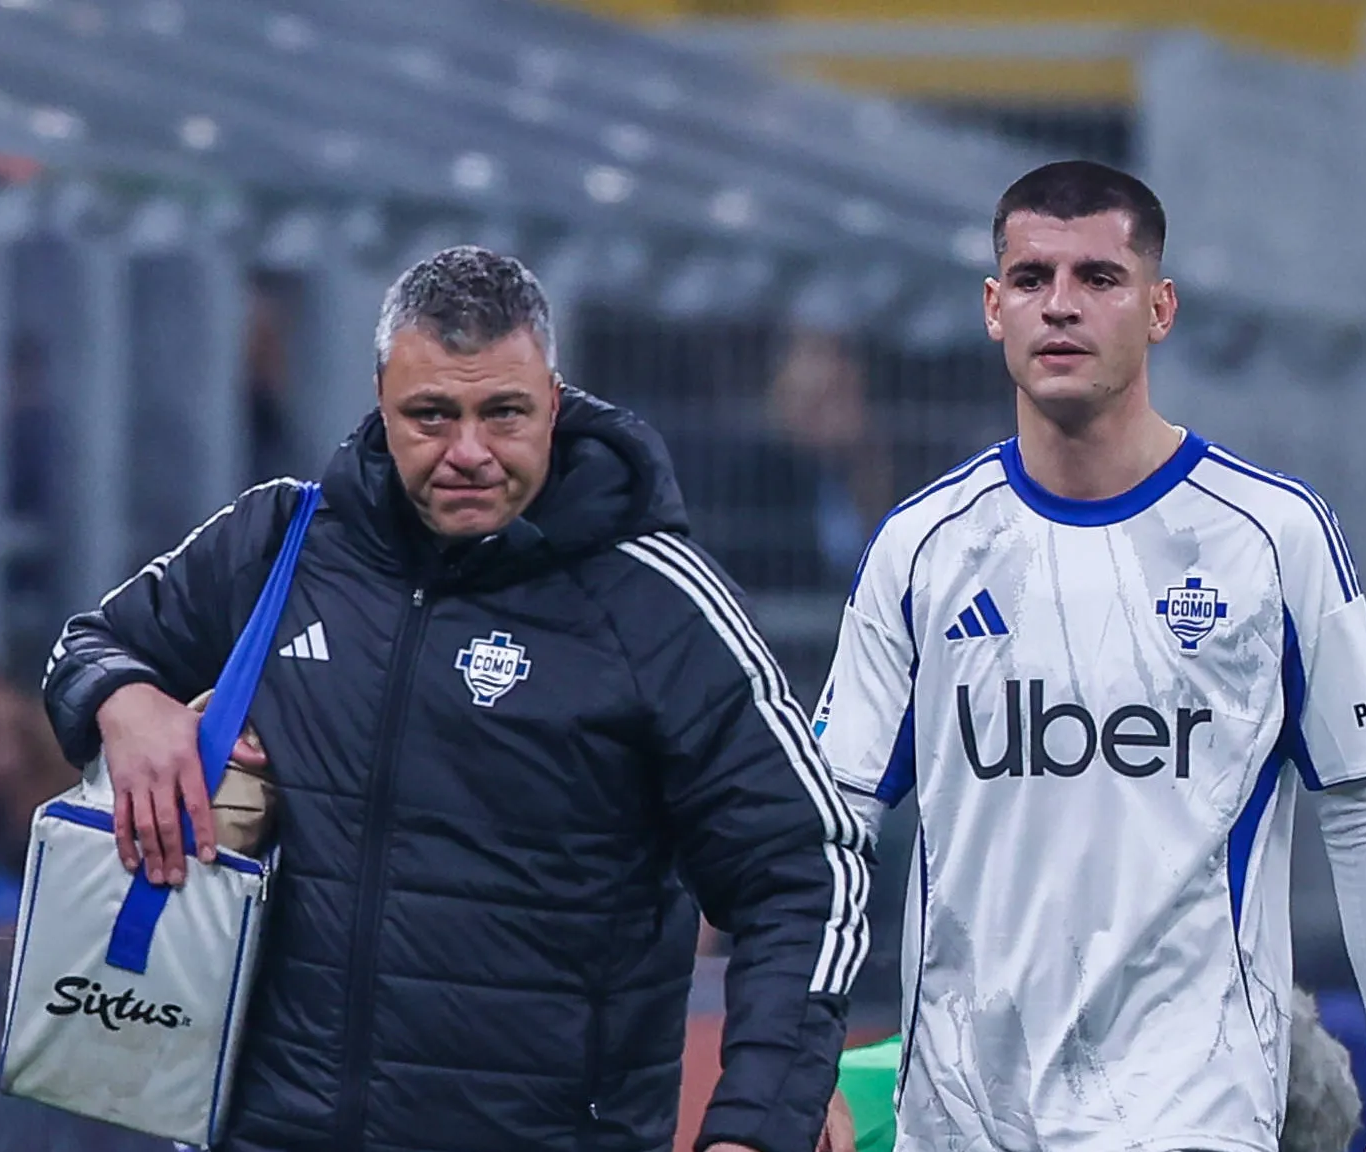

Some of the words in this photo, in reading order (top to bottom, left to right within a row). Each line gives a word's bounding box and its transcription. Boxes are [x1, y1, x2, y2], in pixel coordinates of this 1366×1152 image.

[1171, 599, 1213, 618] COMO
[473, 655, 514, 675] COMO
[956, 679, 1213, 780] Uber
